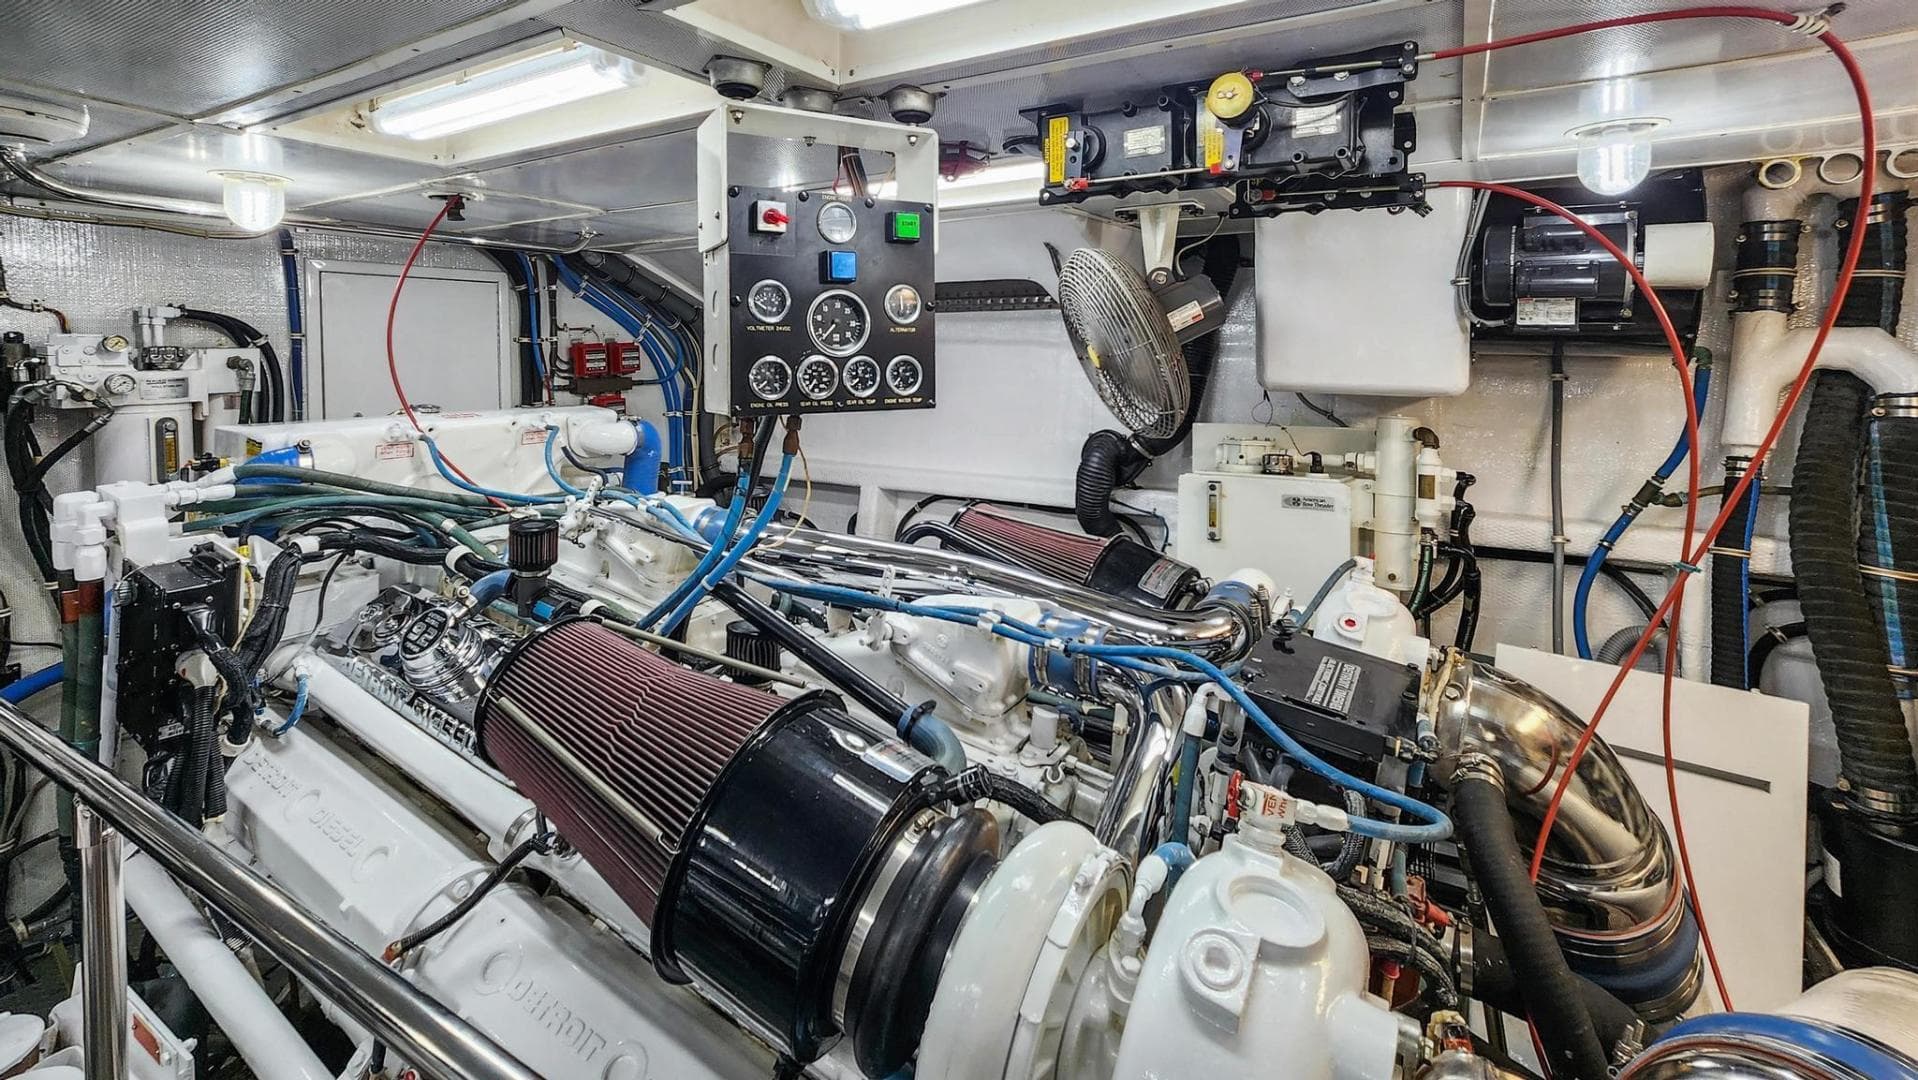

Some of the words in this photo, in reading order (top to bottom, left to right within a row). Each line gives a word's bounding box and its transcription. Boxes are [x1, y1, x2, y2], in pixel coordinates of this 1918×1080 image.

[407, 621, 438, 647] 92
[243, 751, 302, 799] DETROIT
[308, 809, 365, 858] DIESEL
[507, 979, 607, 1062] DETROIT
